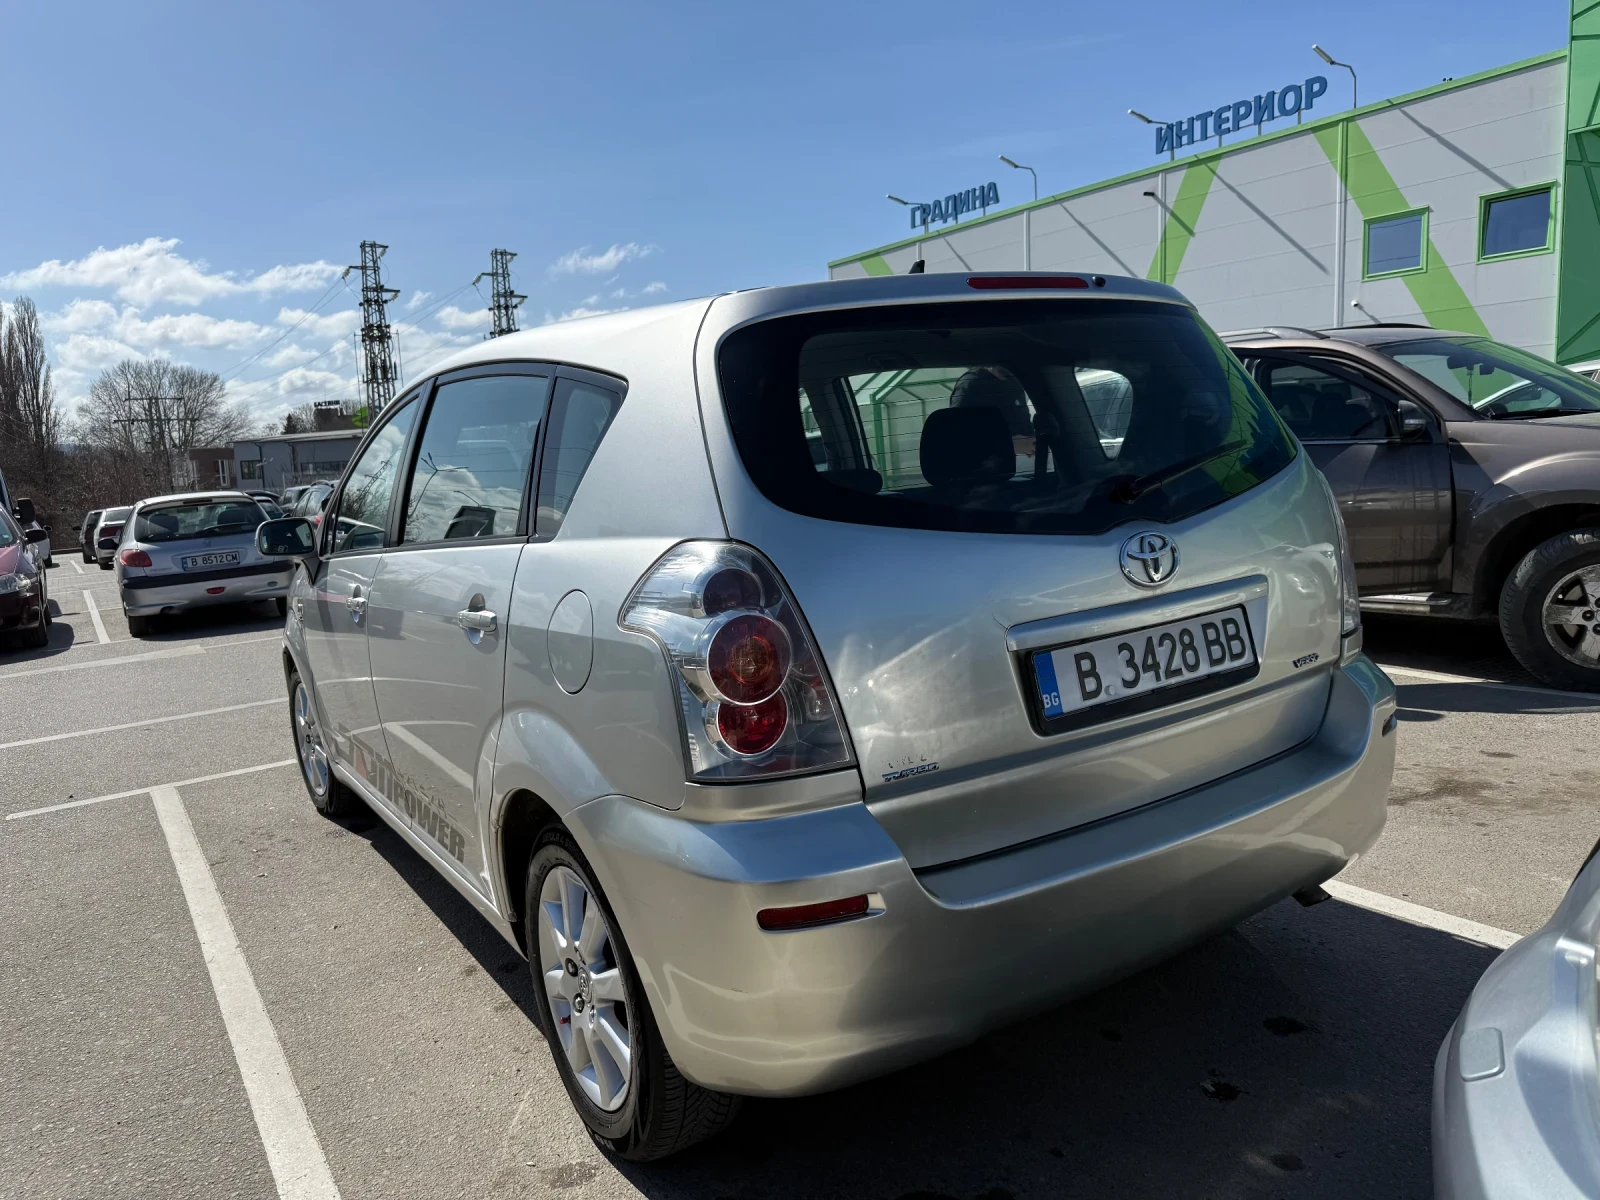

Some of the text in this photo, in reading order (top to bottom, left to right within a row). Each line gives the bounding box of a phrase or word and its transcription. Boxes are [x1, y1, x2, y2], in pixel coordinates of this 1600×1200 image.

[1155, 76, 1328, 155] ИНТЕРИОР
[910, 182, 1000, 229] ГРАДИНА
[190, 557, 198, 567] B
[202, 554, 224, 565] 8512
[225, 552, 238, 563] CM
[1073, 617, 1247, 702] B 3428 BB
[1043, 693, 1060, 709] BG
[881, 761, 940, 783] TURBO
